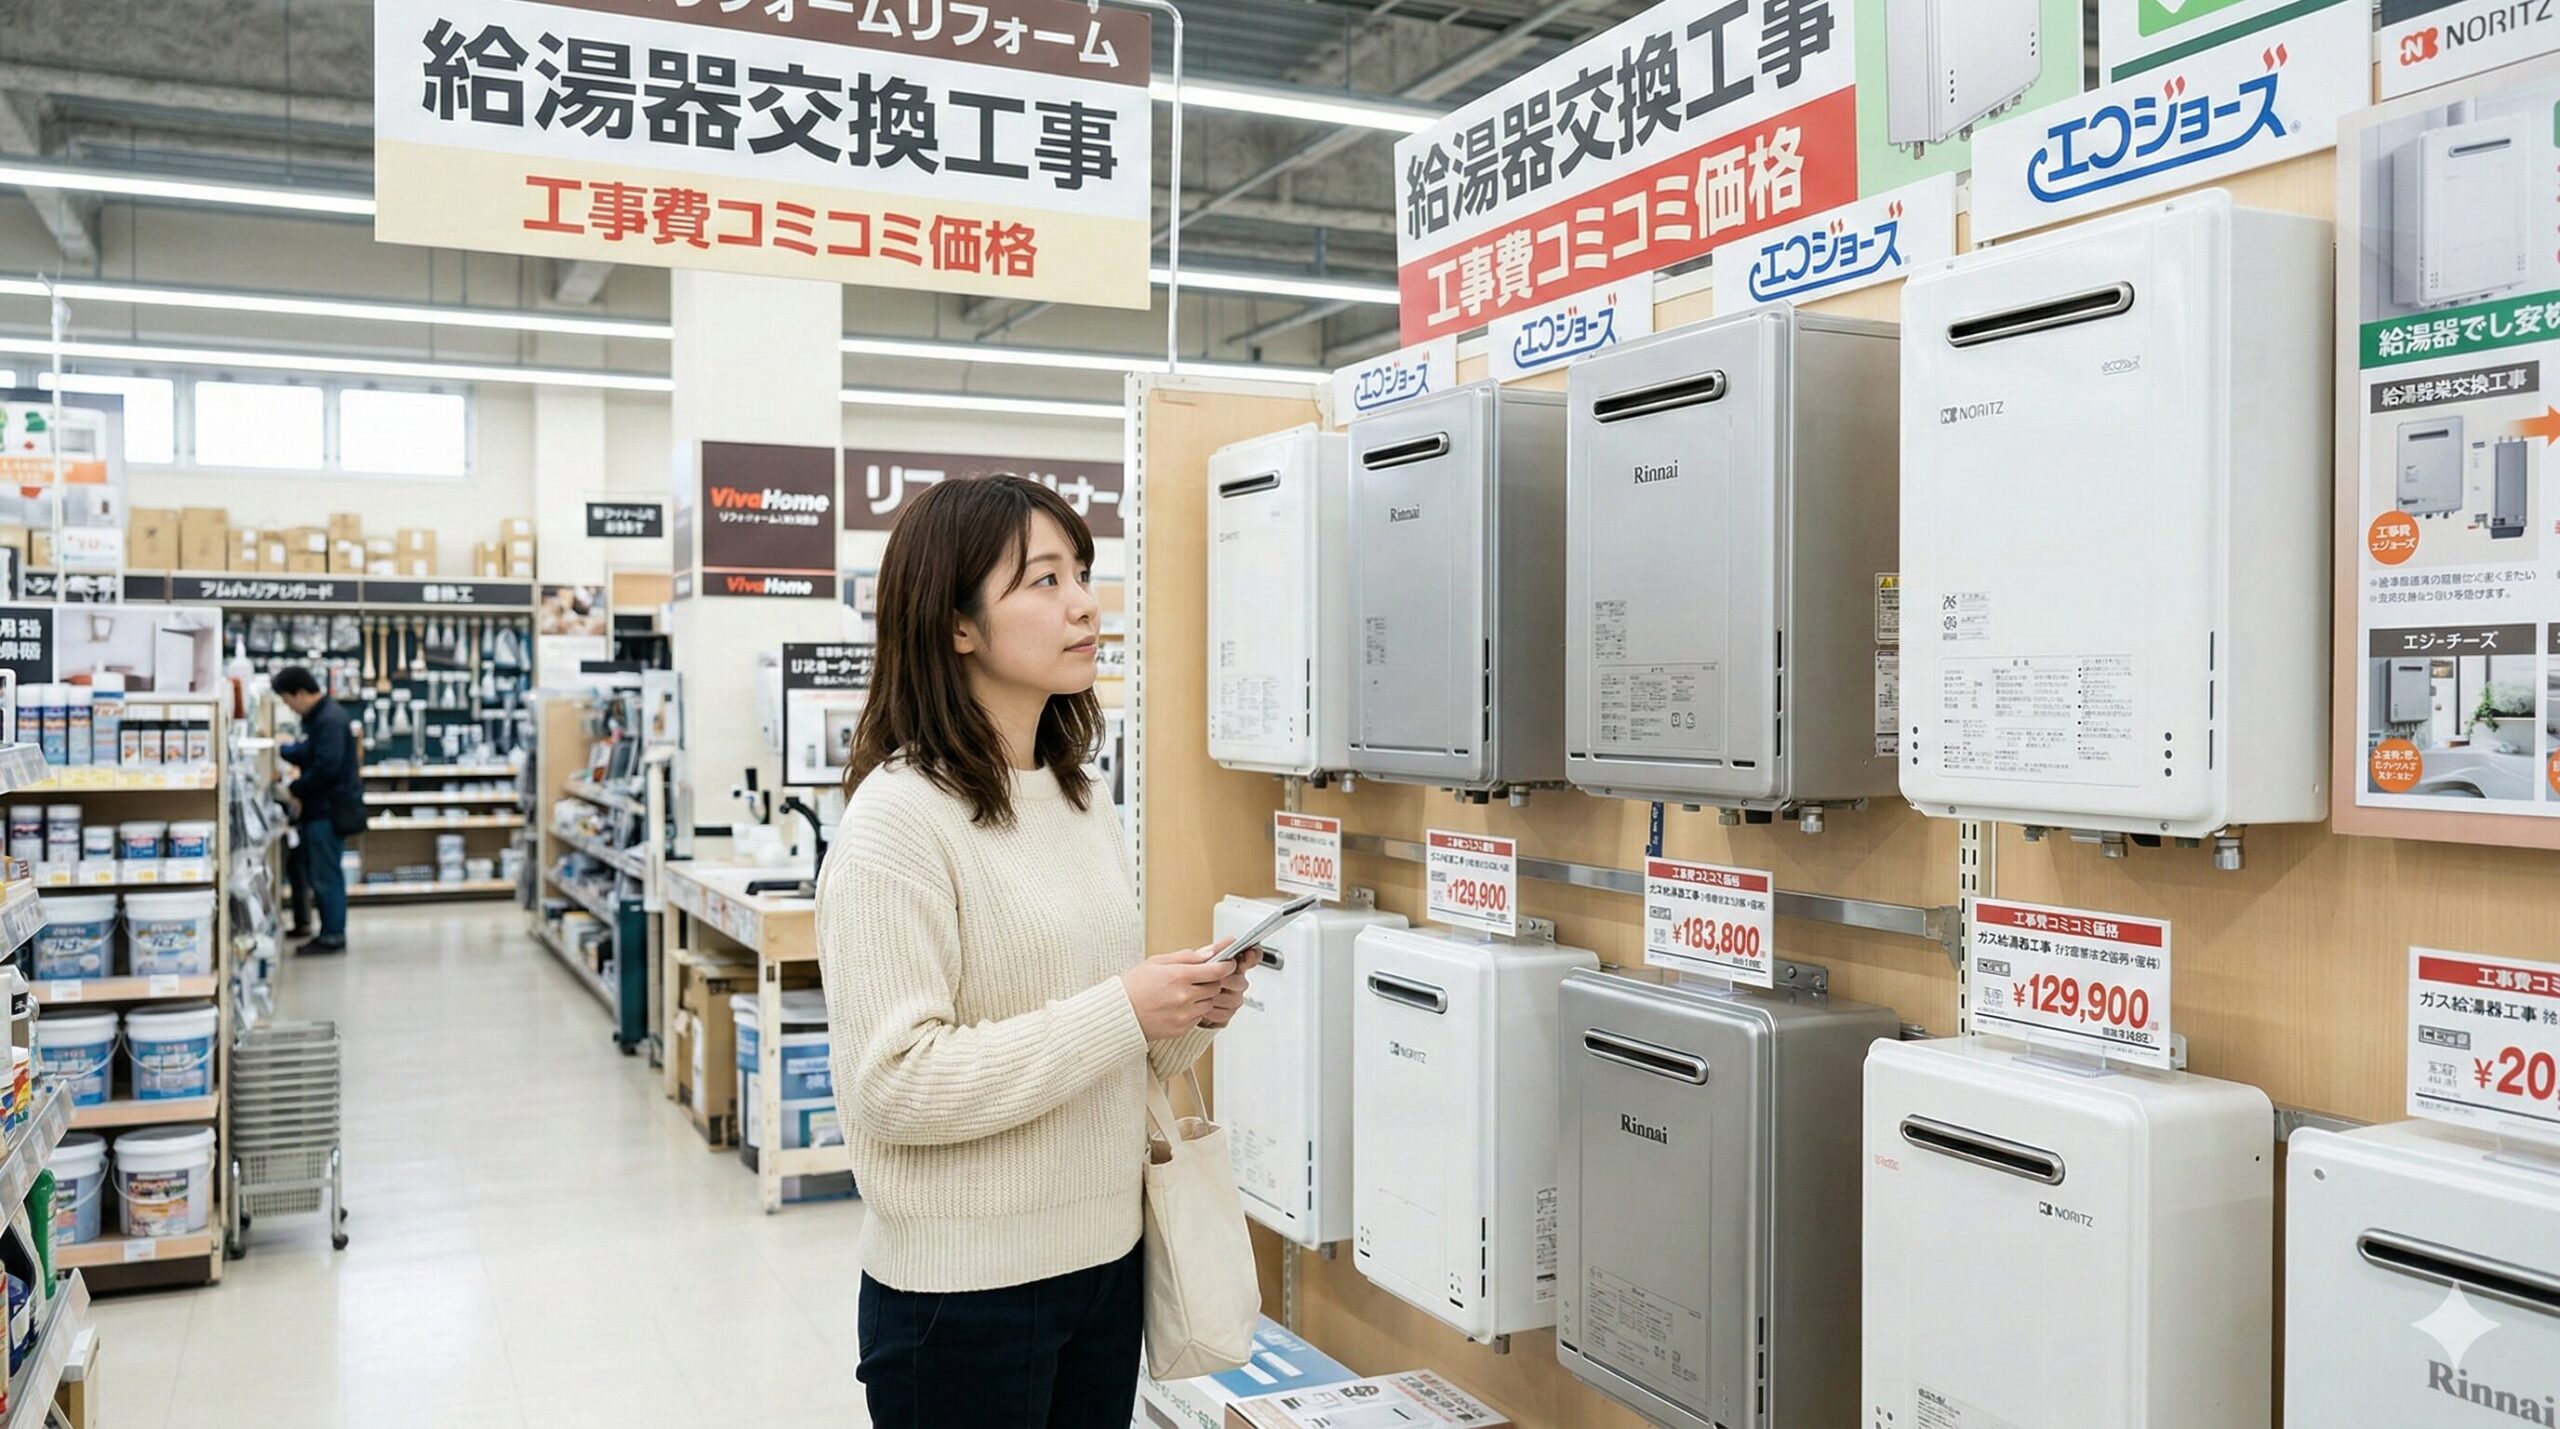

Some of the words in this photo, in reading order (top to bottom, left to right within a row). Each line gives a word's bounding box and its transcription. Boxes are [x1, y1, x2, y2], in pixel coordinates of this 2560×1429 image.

[2446, 0, 2554, 50] NORITZ
[421, 18, 1119, 191] 給湯器交換工事
[1406, 0, 1835, 241] 給湯器交換工事
[522, 174, 1037, 279] 工事費コミコミ価格
[1426, 125, 1806, 327] 工事費コミコミ価格
[1959, 401, 2005, 421] NORITZ
[1633, 459, 1679, 484] Rinnai
[710, 486, 830, 513] VivaHome
[1390, 504, 1421, 523] Rinnai
[726, 576, 813, 595] VivaHome
[1673, 917, 1760, 958] ¥183,800
[2013, 973, 2150, 1030] ¥129,900
[2473, 1046, 2560, 1111] ¥20
[1620, 1114, 1668, 1145] Rinnai
[2054, 1206, 2094, 1228] NORITZ
[2427, 1359, 2556, 1429] Rinnai
